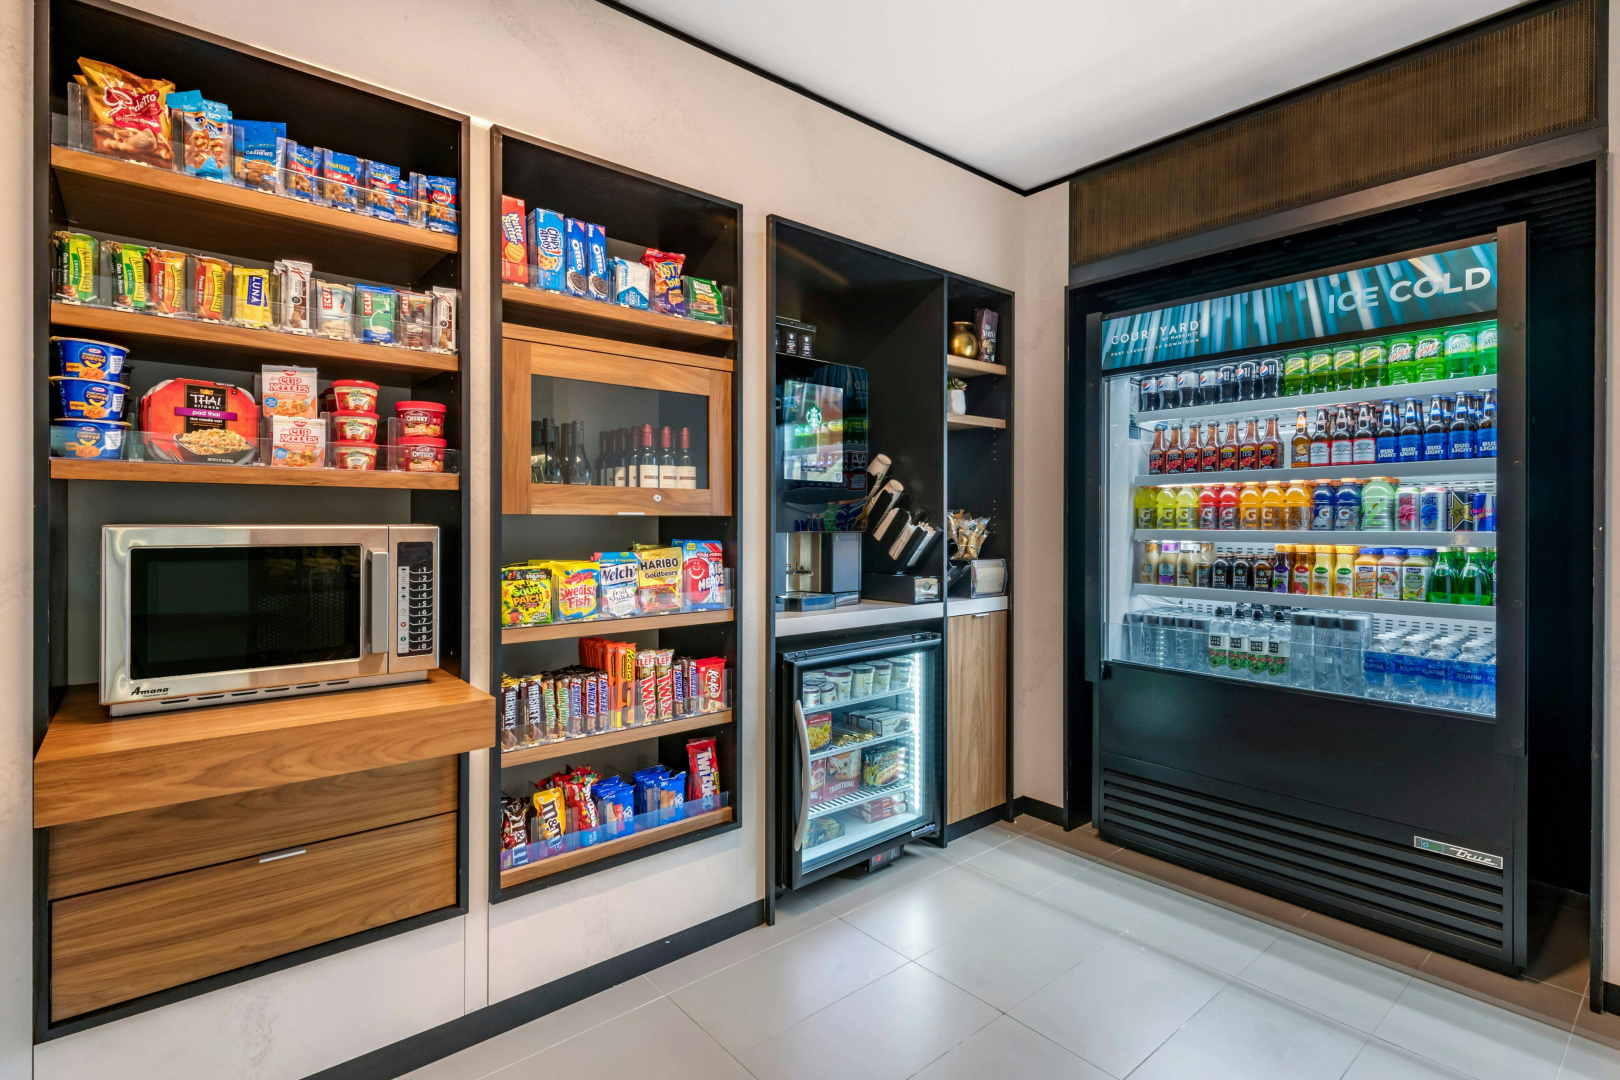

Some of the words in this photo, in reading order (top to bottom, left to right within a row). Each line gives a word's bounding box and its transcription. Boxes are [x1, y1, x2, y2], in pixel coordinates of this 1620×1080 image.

[502, 215, 519, 245] Butter
[508, 212, 525, 243] Nutter
[546, 226, 560, 251] Chips
[571, 238, 582, 271] OREO
[592, 243, 603, 275] OREO
[251, 276, 261, 303] LUNA
[1329, 285, 1379, 314] ICE
[1389, 267, 1492, 303] COLD
[364, 293, 372, 310] CLIF
[1111, 320, 1199, 345] COURTYARD
[1170, 331, 1199, 340] MARRIOTT
[1164, 338, 1200, 348] DOWNTOWN
[269, 383, 310, 393] NOODLES
[278, 376, 302, 386] CUP
[189, 394, 222, 406] THAI
[406, 415, 428, 423] CHUNKY
[279, 433, 319, 445] NOODLES
[289, 427, 311, 436] CUP
[640, 557, 678, 571] HARIBO
[644, 570, 678, 579] Goldbears
[698, 574, 724, 592] HEADS
[512, 586, 540, 597] SOUR
[513, 593, 543, 606] PATCH
[559, 584, 597, 601] Swedish
[612, 589, 628, 597] Fruit
[566, 595, 591, 610] Fish
[626, 648, 635, 682] Reese's
[1456, 672, 1482, 681] AQUAFINA
[131, 686, 169, 696] Amana
[641, 671, 656, 719] TWIX
[657, 669, 673, 717] TWIX
[675, 671, 683, 702] SNICKERS
[528, 683, 540, 723] HERSHEY'S
[572, 684, 581, 718] SNICKERS
[588, 682, 596, 716] SNICKERS
[600, 680, 608, 714] SNICKERS
[505, 691, 516, 730] HERSHEY'S
[828, 780, 855, 794] TRADITIONAL
[1449, 847, 1497, 866] True
